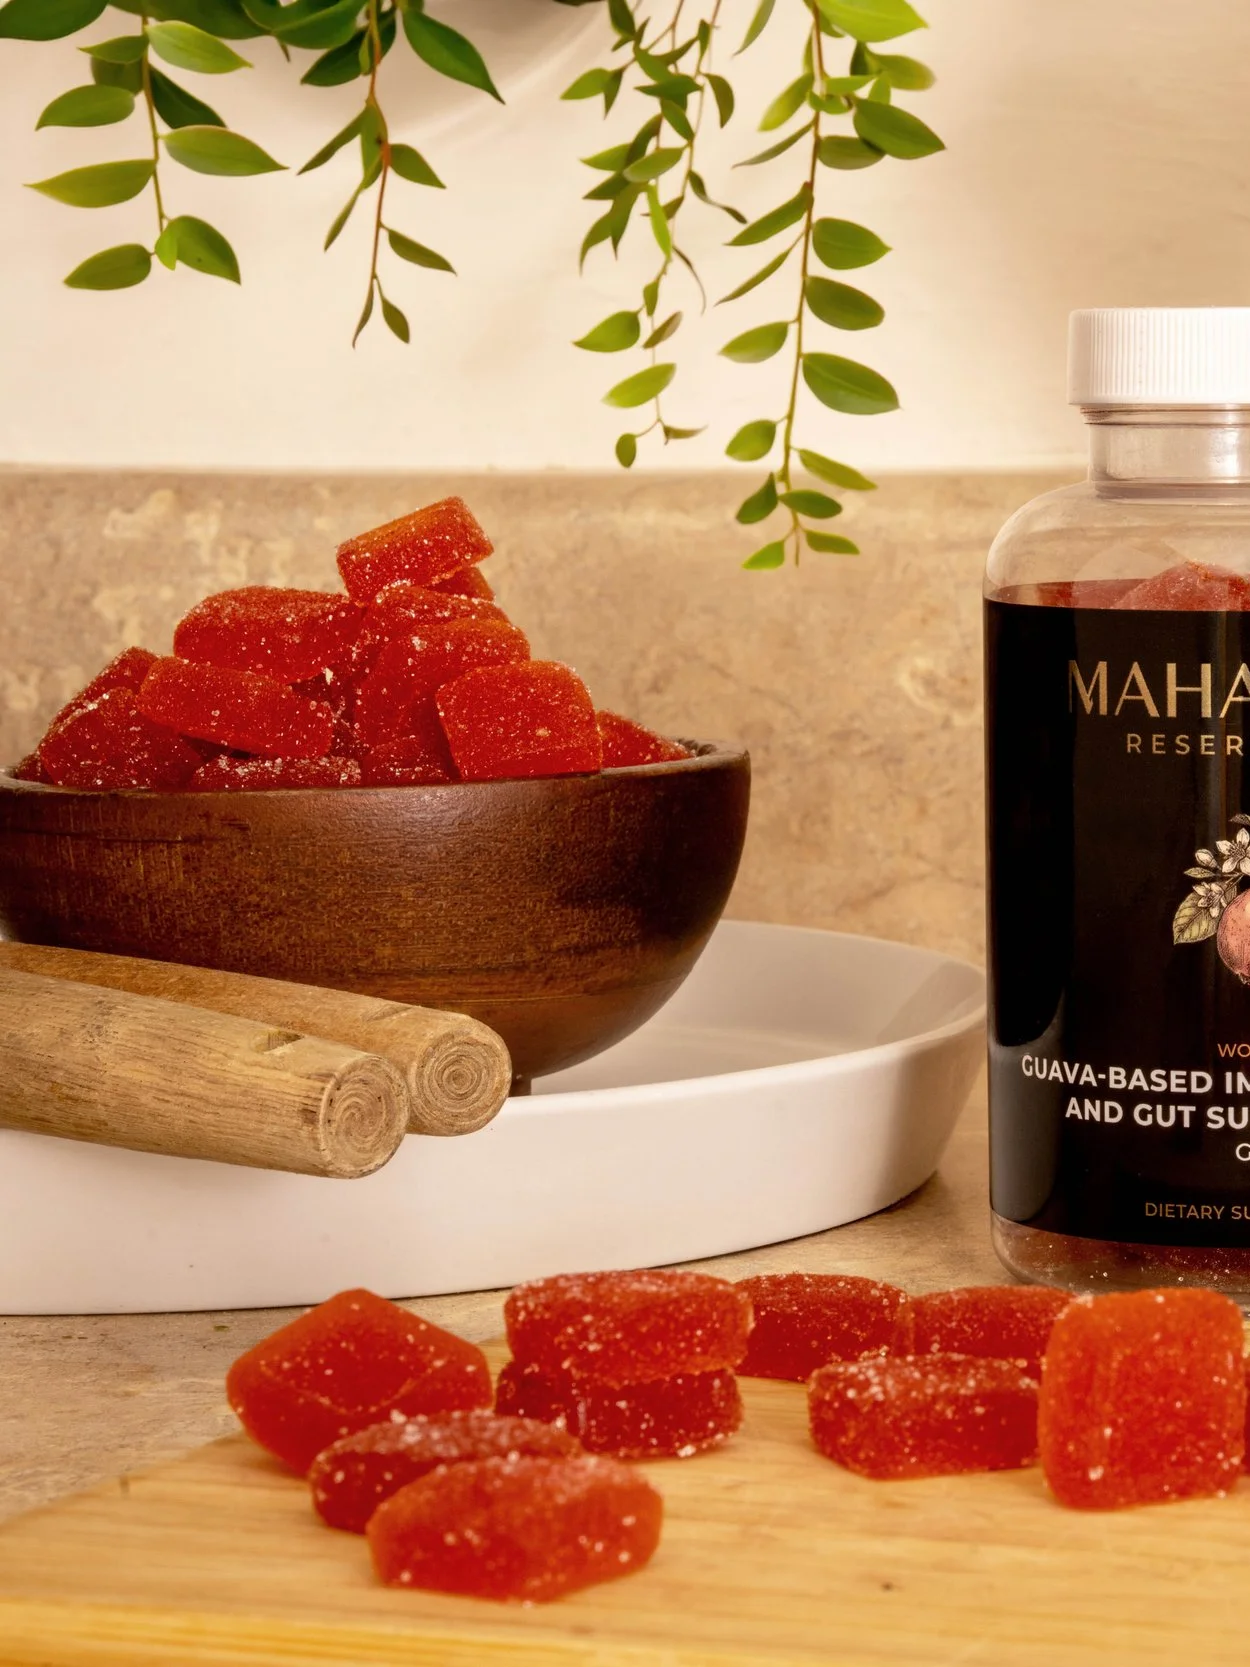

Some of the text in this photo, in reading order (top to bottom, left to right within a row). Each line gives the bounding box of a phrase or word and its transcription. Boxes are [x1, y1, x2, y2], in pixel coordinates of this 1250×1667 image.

[1021, 1054, 1213, 1093] GUAVA-BASED
[1065, 1097, 1123, 1124] AND
[1133, 1105, 1196, 1128] GUT
[1144, 1203, 1225, 1219] DIETARY
